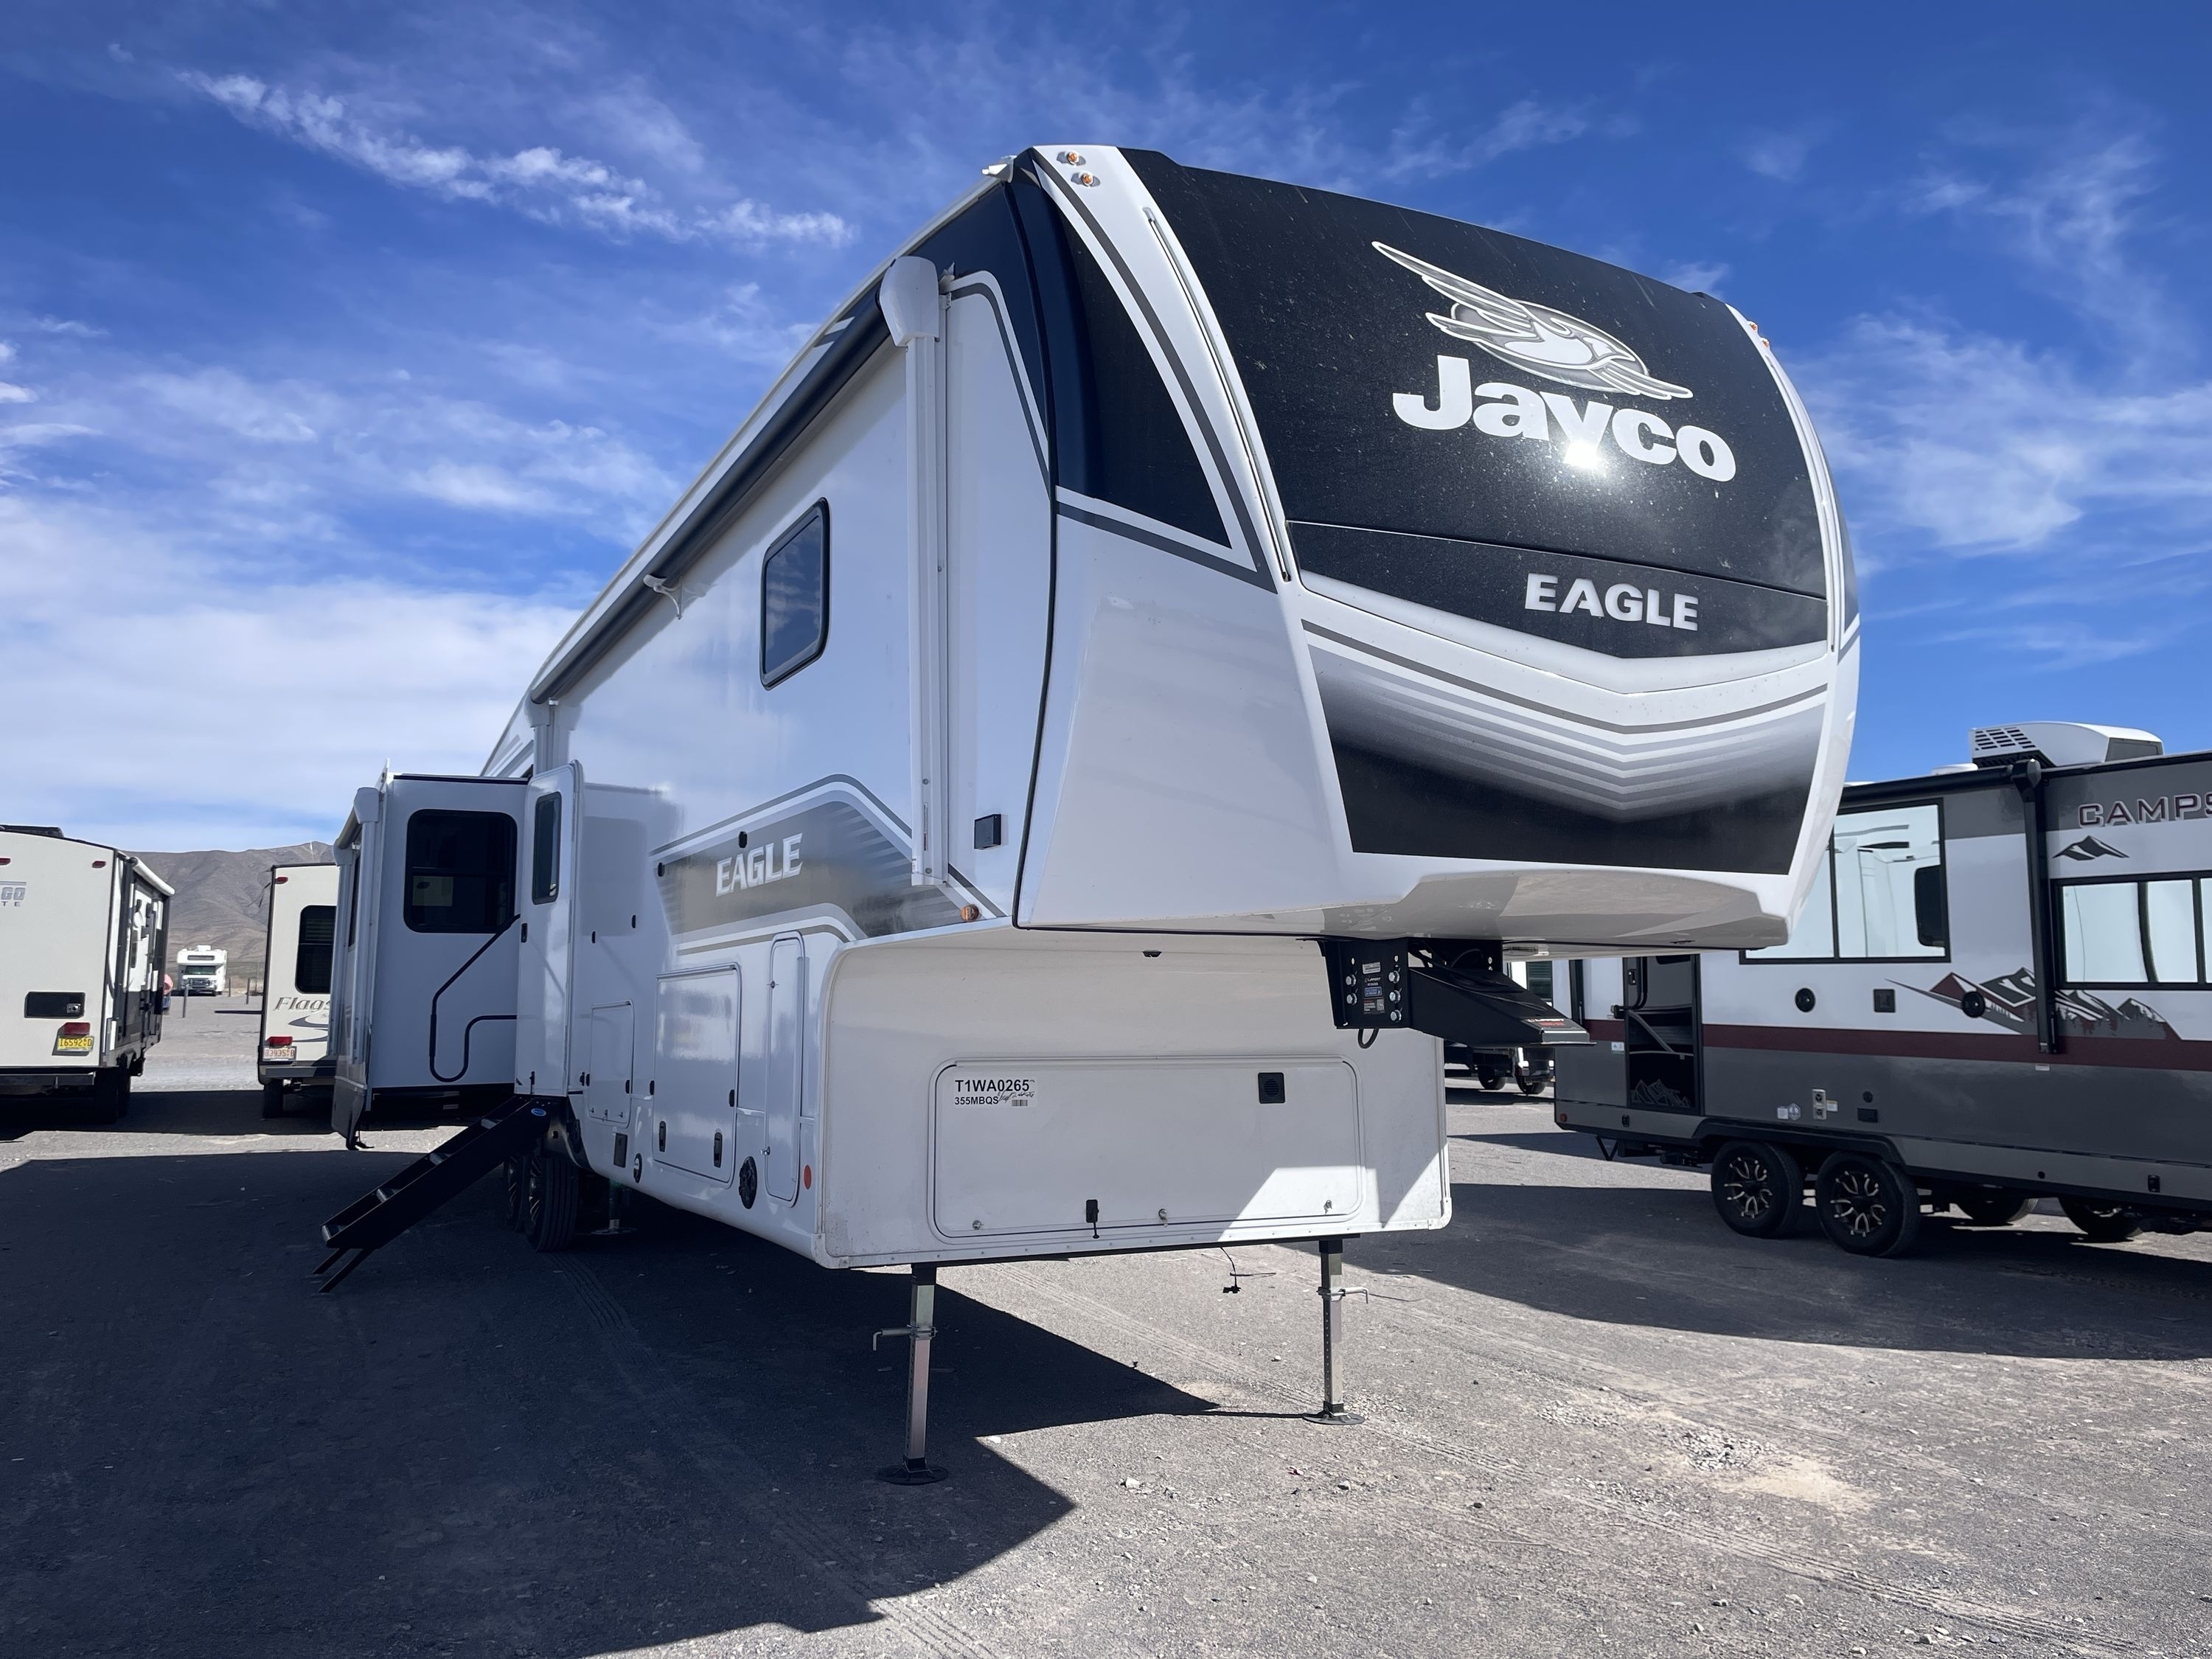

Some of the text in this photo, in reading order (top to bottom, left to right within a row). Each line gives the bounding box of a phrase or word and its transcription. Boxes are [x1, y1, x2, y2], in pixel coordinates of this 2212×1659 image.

[1393, 355, 1736, 482] Jayco
[1524, 573, 1699, 631] EAGLE
[716, 833, 803, 897] EAGLE
[955, 1079, 1029, 1092] T1WA0265
[955, 1096, 999, 1105] 355MBQS
